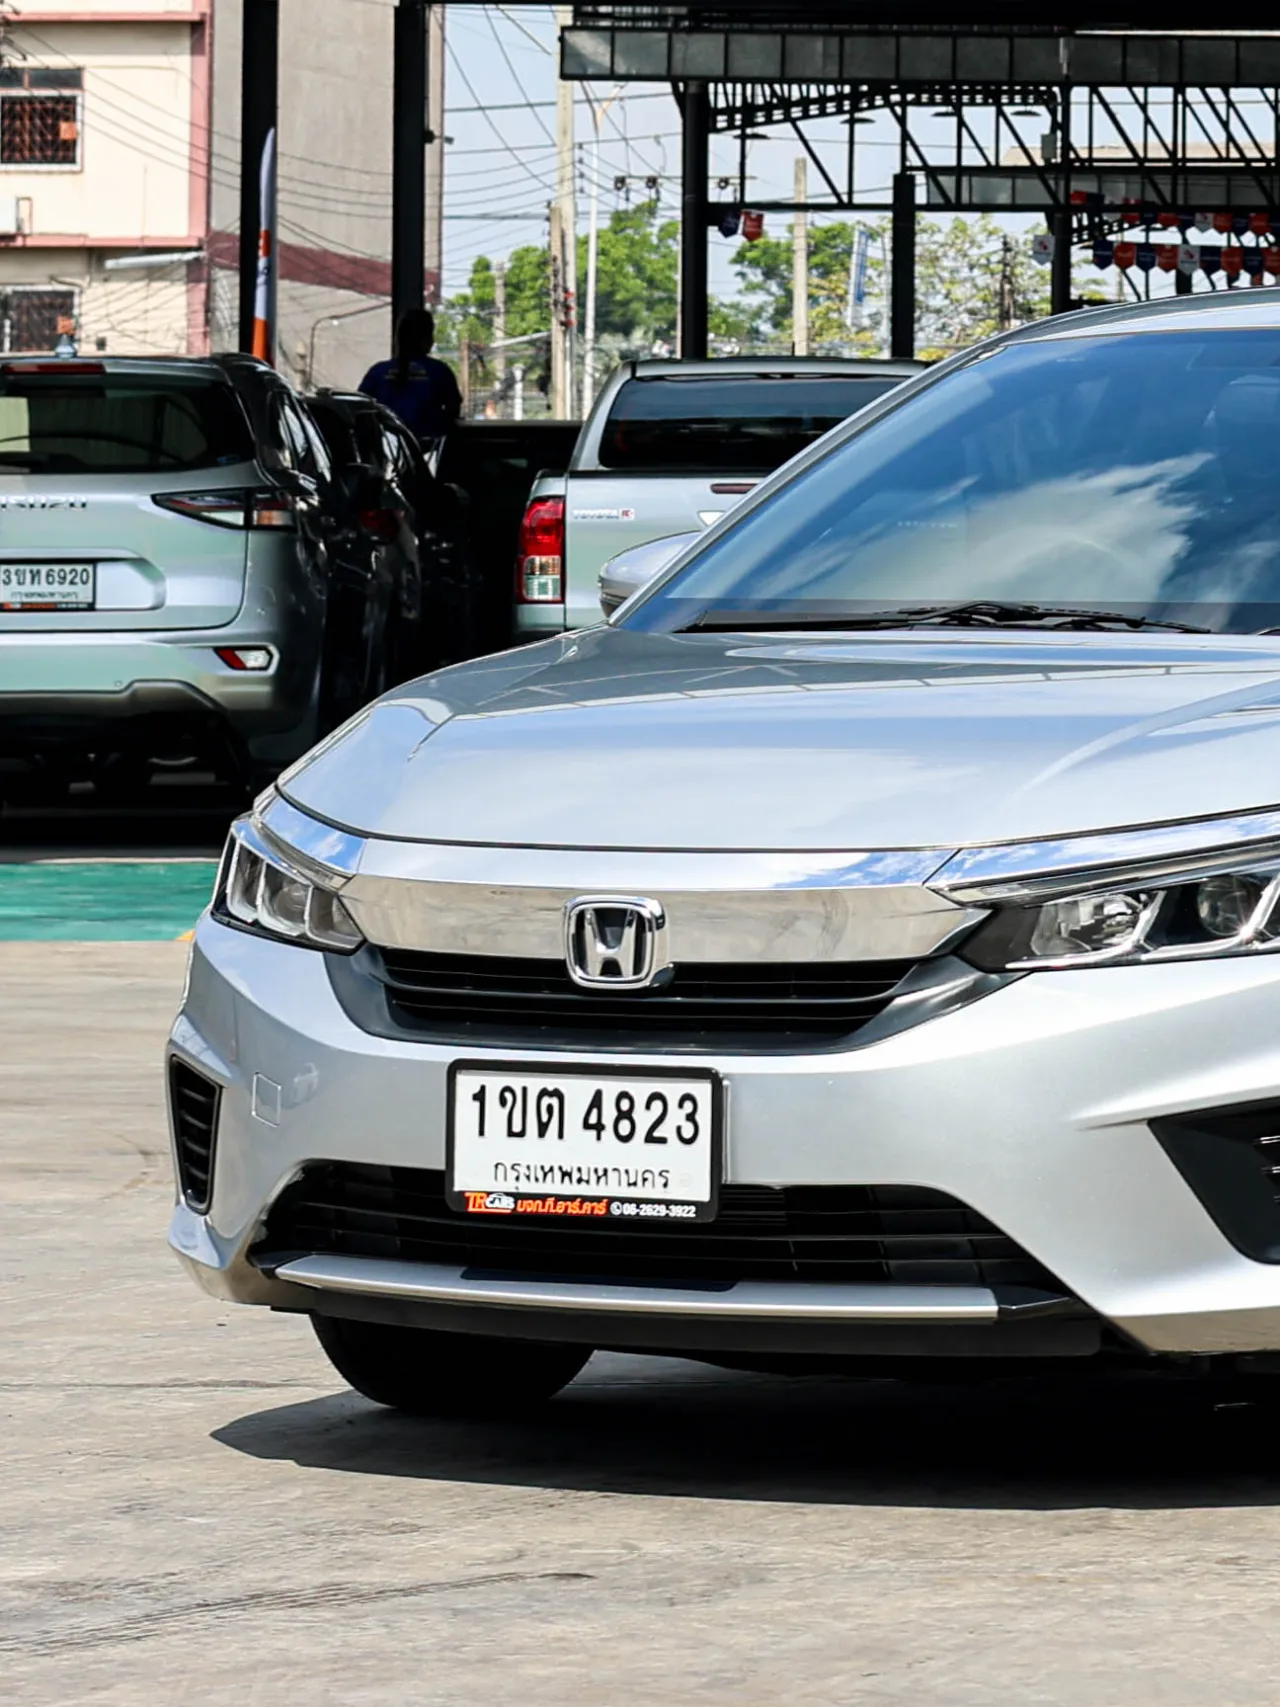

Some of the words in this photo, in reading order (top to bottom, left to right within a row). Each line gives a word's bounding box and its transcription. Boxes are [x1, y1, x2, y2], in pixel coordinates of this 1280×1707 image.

[45, 568, 90, 586] 6920
[472, 1084, 565, 1140] 1ขต
[582, 1088, 700, 1145] 4823
[493, 1161, 671, 1192] กรุงเทพมหานคร
